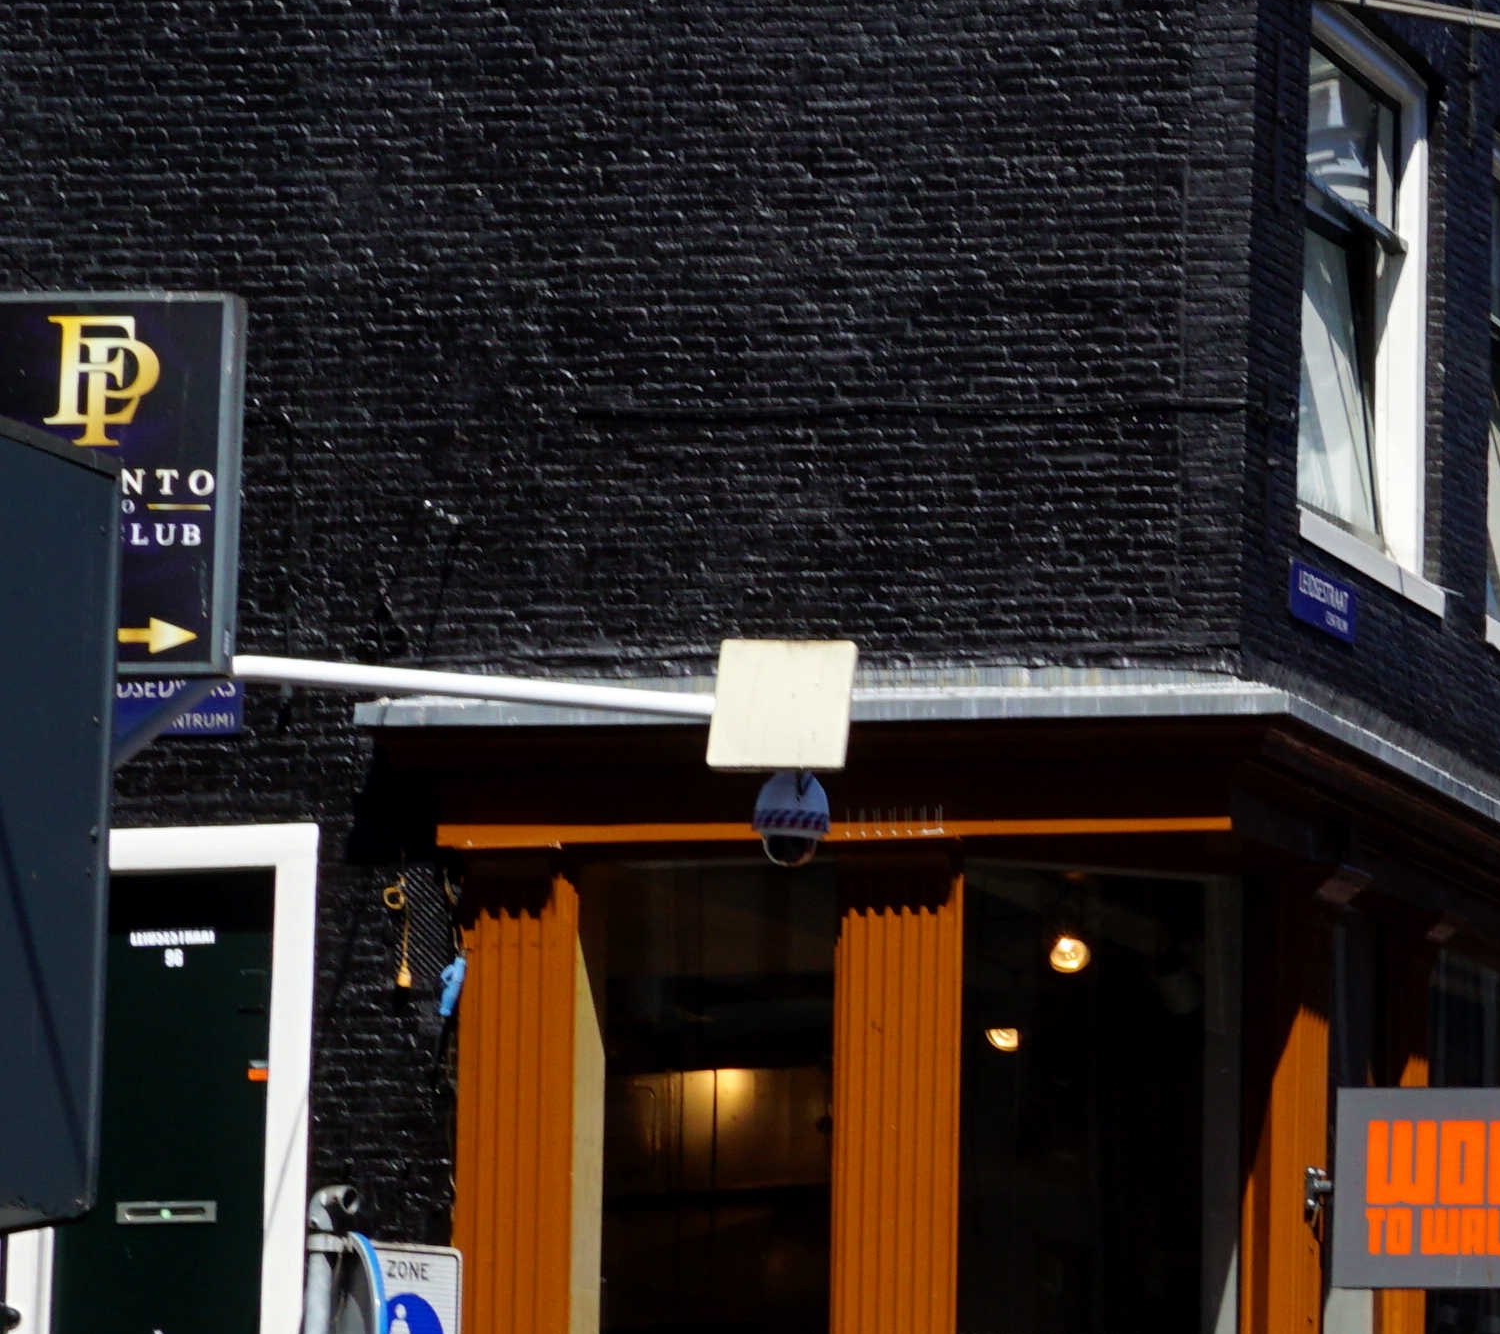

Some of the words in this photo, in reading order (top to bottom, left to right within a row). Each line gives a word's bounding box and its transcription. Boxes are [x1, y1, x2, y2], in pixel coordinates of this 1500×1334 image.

[119, 468, 215, 496] NTO
[120, 523, 202, 547] LUB
[1365, 1207, 1412, 1255] TO
[386, 1260, 430, 1282] ZONE
